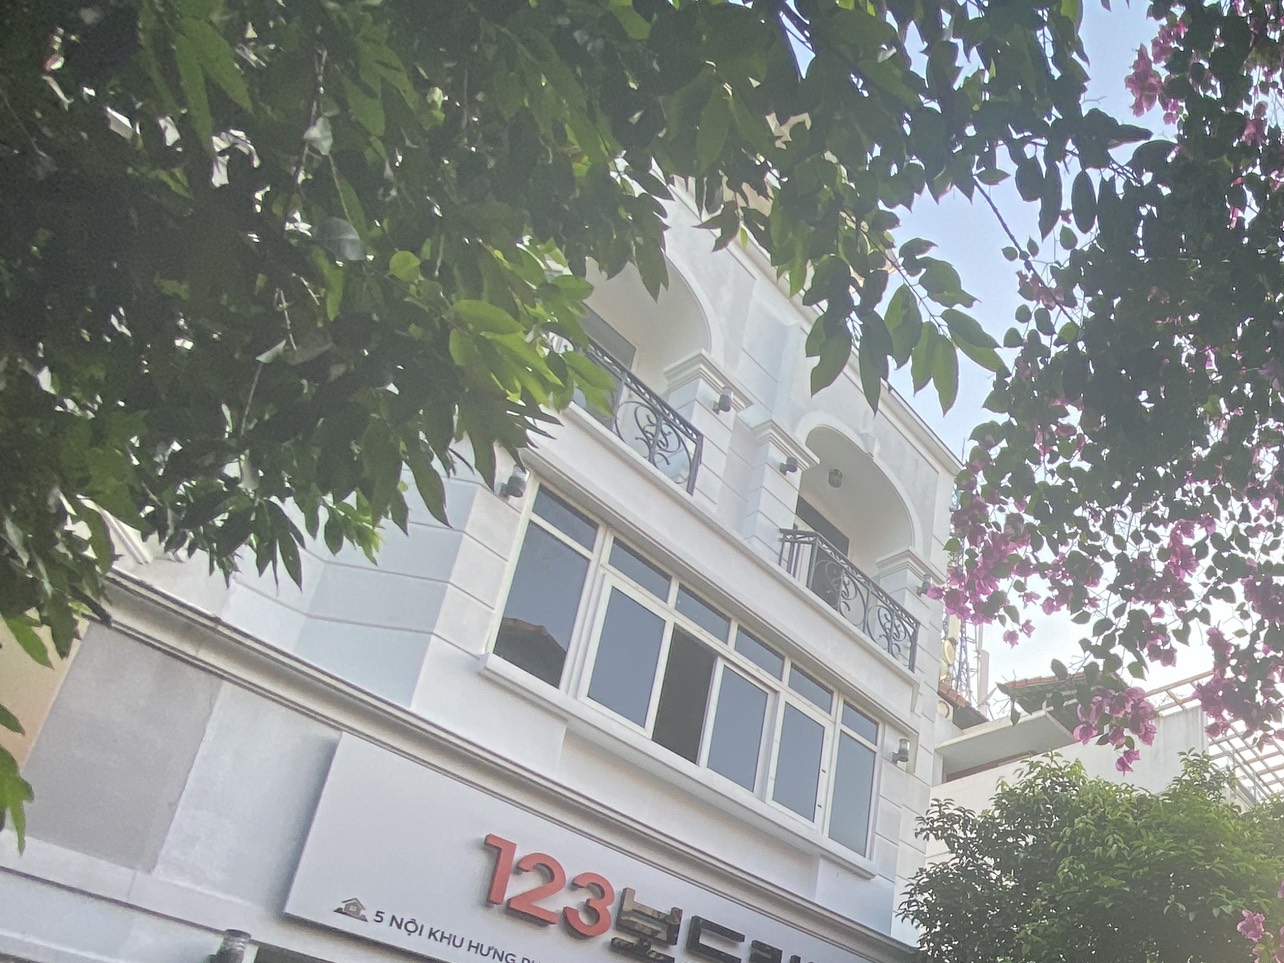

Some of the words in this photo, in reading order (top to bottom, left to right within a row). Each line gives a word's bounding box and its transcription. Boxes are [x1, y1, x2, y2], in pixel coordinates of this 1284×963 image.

[373, 910, 385, 923] 5
[389, 914, 425, 937] NỘI
[427, 927, 465, 949] KHU
